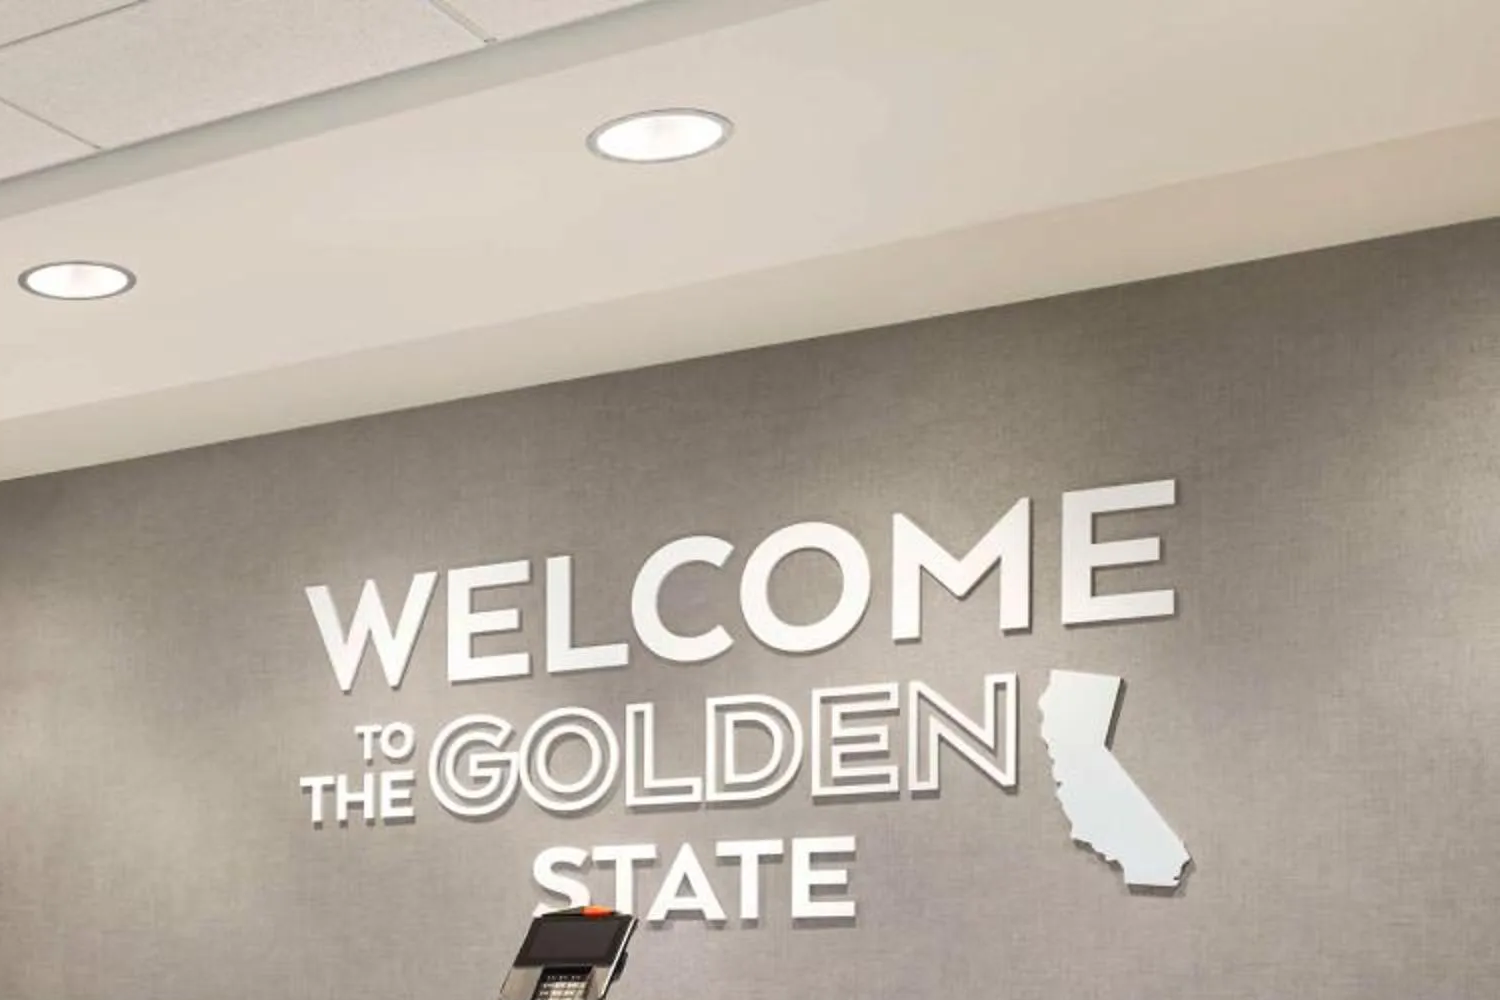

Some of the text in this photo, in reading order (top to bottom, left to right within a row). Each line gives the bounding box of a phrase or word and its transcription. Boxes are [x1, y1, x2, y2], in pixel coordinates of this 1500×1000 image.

[305, 480, 1175, 692] WELCOME
[299, 671, 1018, 823] THE GOLDEN
[354, 721, 415, 761] TO
[531, 836, 856, 922] STATE
